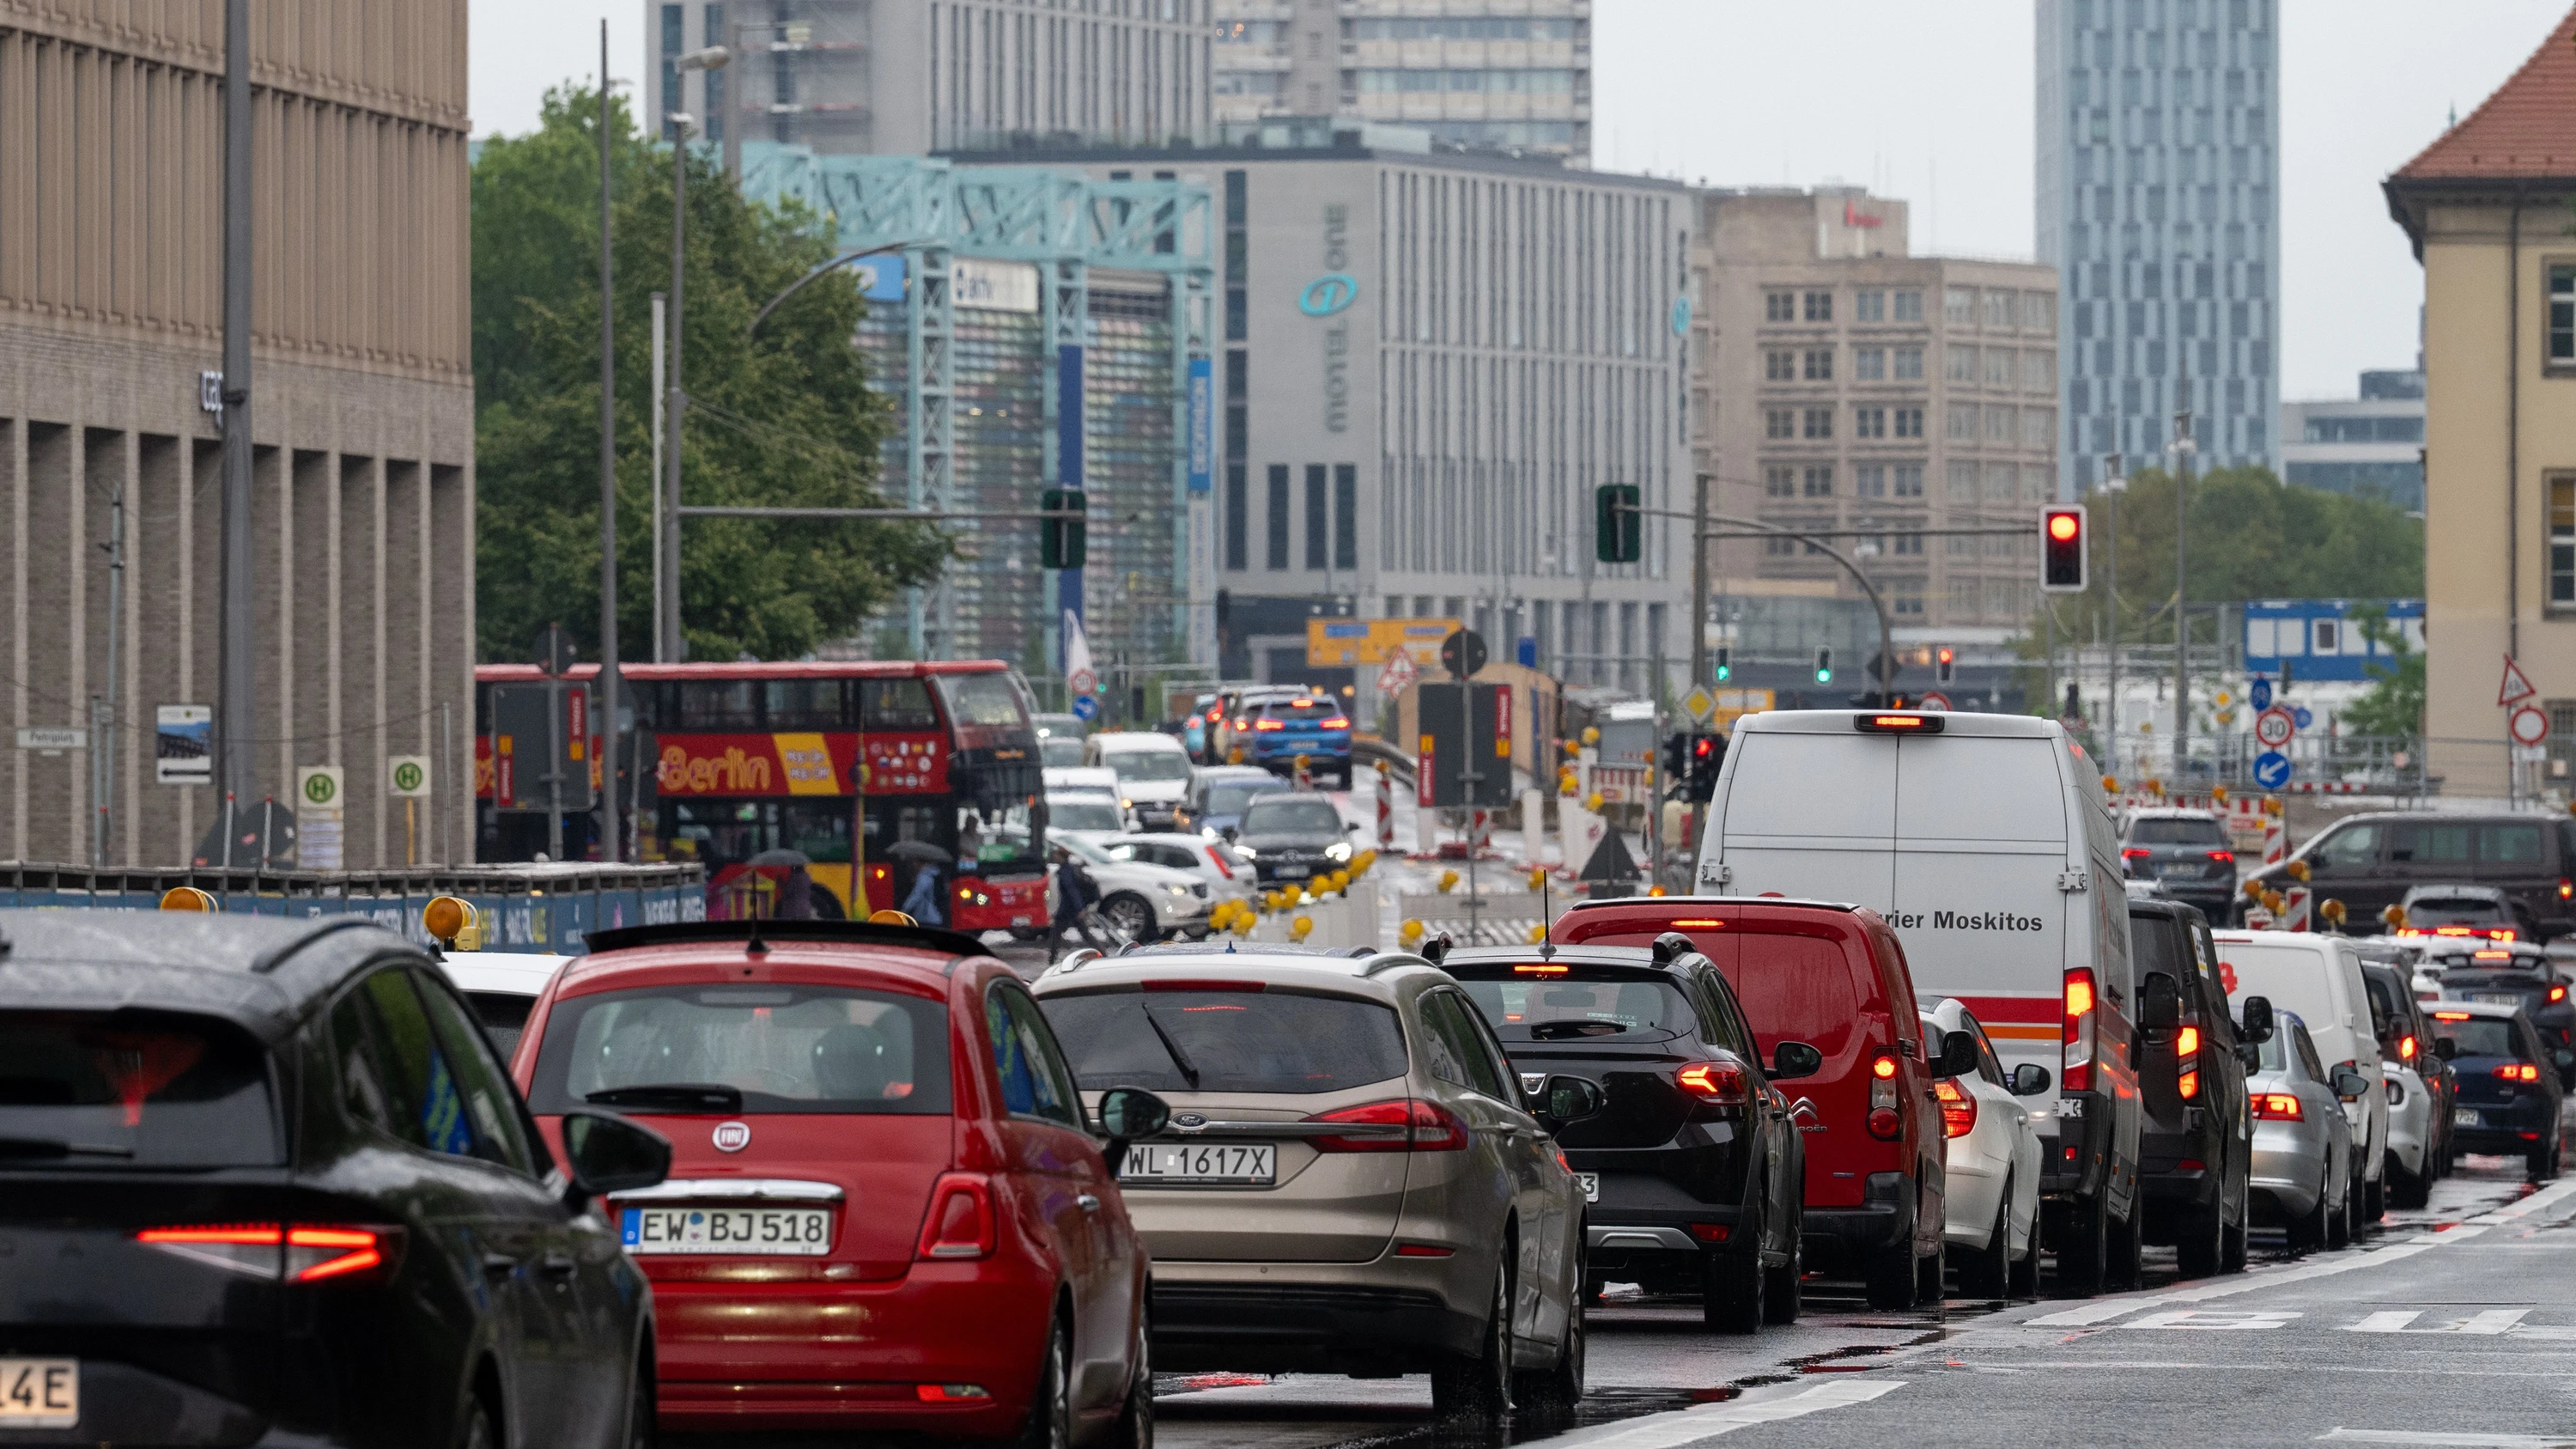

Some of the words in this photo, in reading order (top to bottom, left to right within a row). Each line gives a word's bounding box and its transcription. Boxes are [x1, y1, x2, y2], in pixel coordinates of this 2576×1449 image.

[2262, 720, 2287, 737] 30
[662, 746, 771, 792] Berlin
[1880, 910, 1924, 928] rier
[1934, 911, 2043, 932] Moskitos
[1178, 1116, 1200, 1126] Ford
[720, 1128, 744, 1143] FIAT
[1128, 1147, 1163, 1174] WL
[1179, 1148, 1267, 1175] 1617X
[643, 1213, 686, 1241] EW
[0, 1367, 70, 1409] 4E
